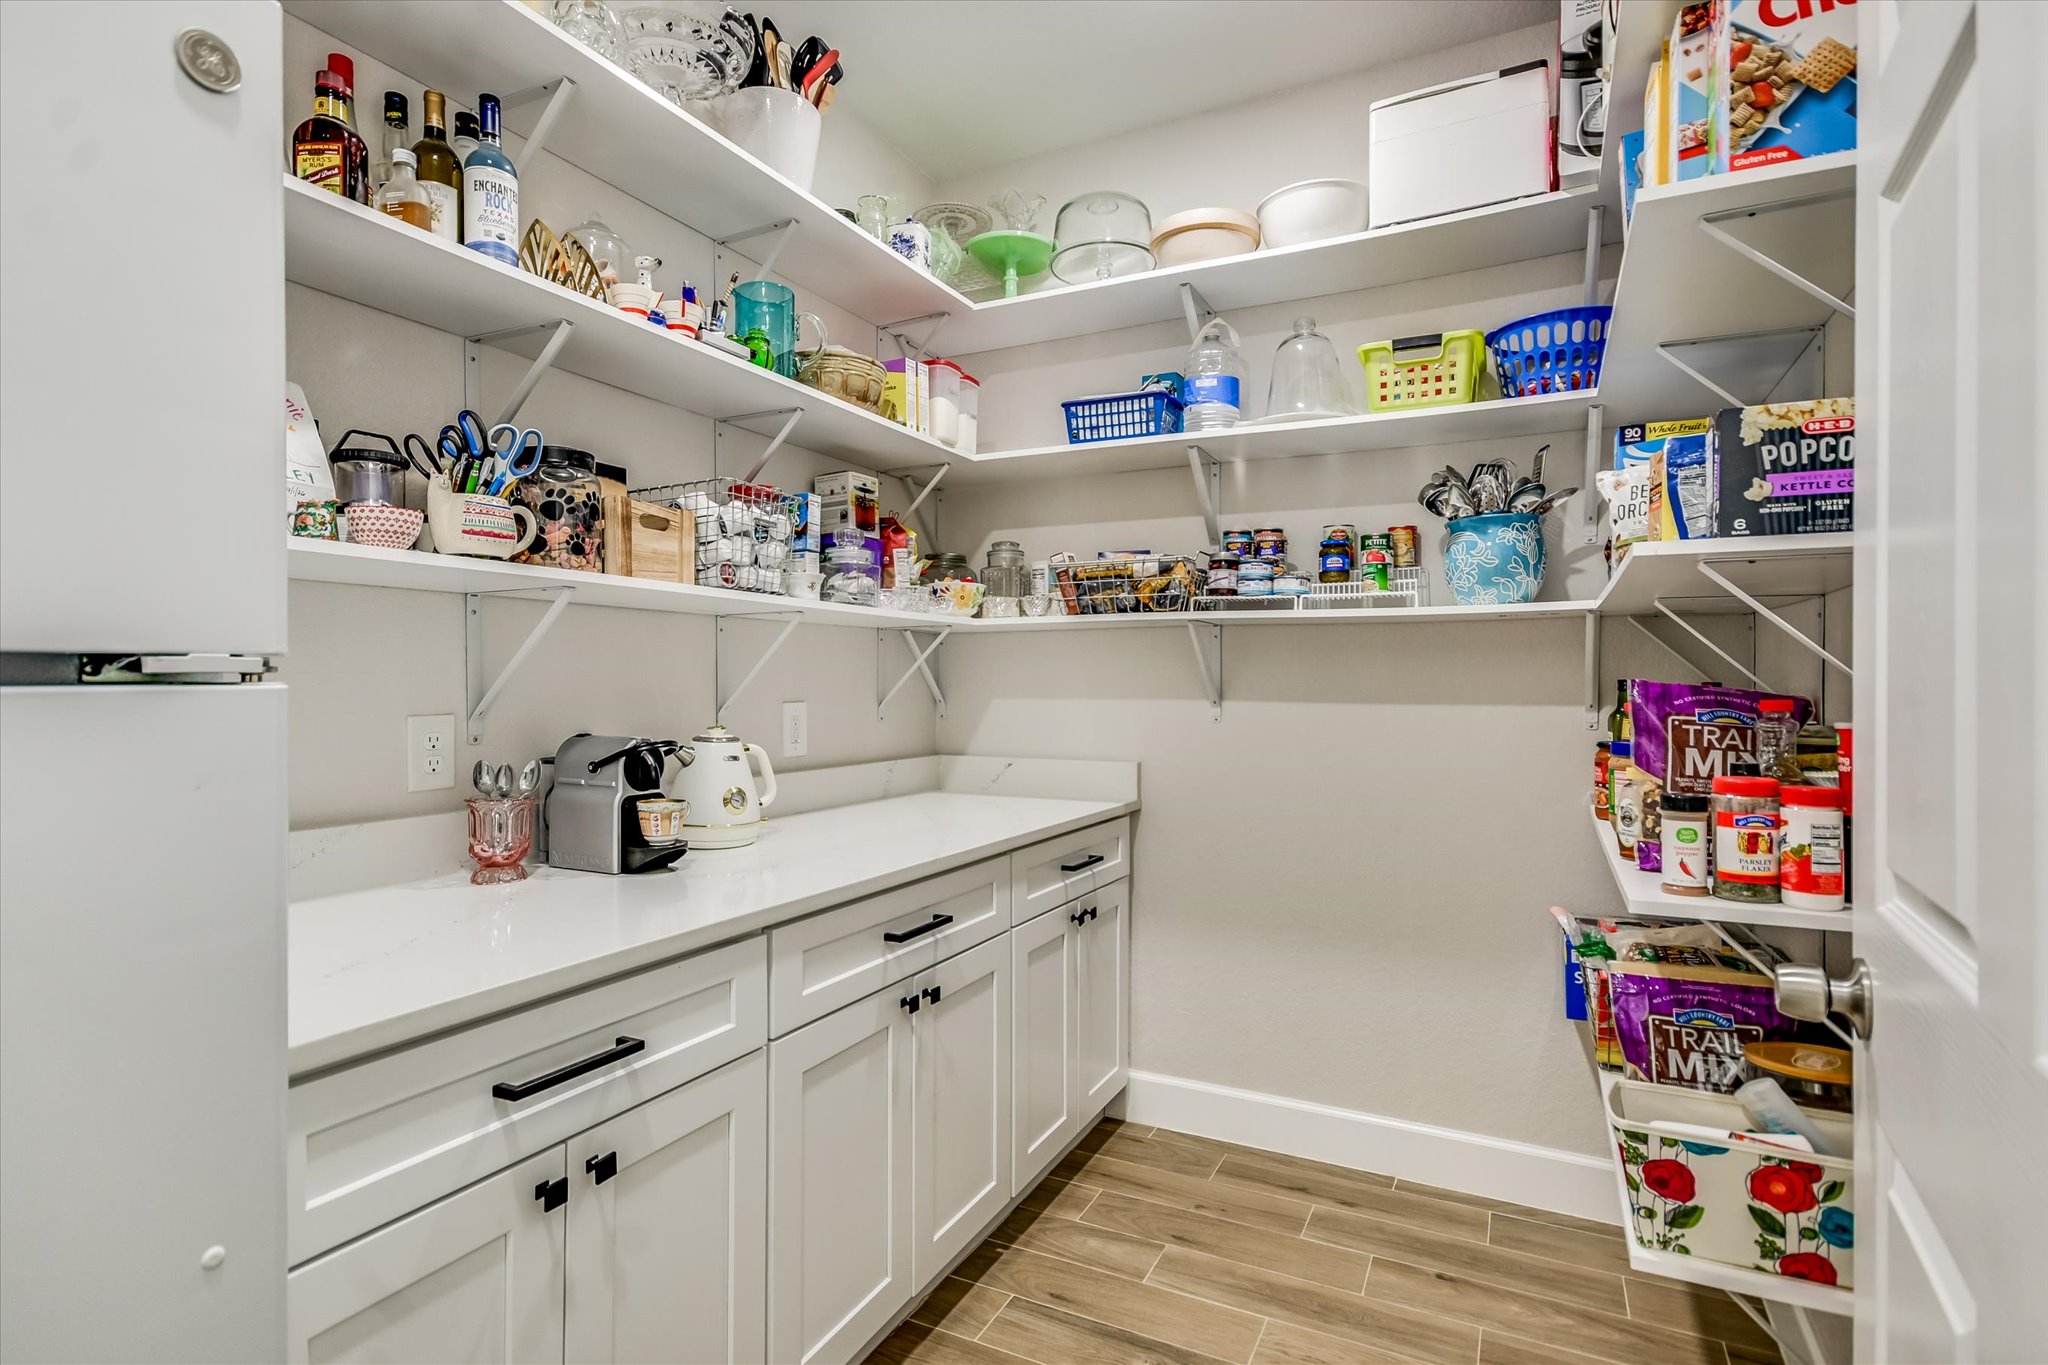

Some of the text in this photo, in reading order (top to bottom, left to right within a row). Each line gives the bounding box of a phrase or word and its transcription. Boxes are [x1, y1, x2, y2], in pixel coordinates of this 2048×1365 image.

[1733, 156, 1766, 167] Gluten
[1767, 150, 1789, 161] Free
[485, 191, 513, 215] ROCK
[483, 208, 514, 223] TEXAS
[1648, 423, 1678, 434] Whole
[1679, 422, 1702, 432] Fruit
[1807, 419, 1852, 431] H-E-B
[1624, 427, 1642, 438] 90
[1760, 435, 1855, 470] POPCO
[1780, 480, 1832, 491] KETTLE
[1814, 498, 1850, 506] GLUTEN
[1733, 518, 1747, 530] 6
[1365, 538, 1388, 546] PETITE
[1684, 694, 1716, 703] CERTIFIED
[1717, 695, 1751, 706] SYNTHETIC
[1701, 712, 1715, 722] HILL
[1714, 710, 1739, 719] COUNTRY
[1739, 857, 1773, 866] PARSLEY
[1730, 1002, 1756, 1017] COLORS
[1679, 1012, 1690, 1023] HILL
[1690, 1011, 1715, 1020] COUNTRY
[1662, 1024, 1744, 1055] TRAIL
[1667, 1048, 1747, 1086] MIX
